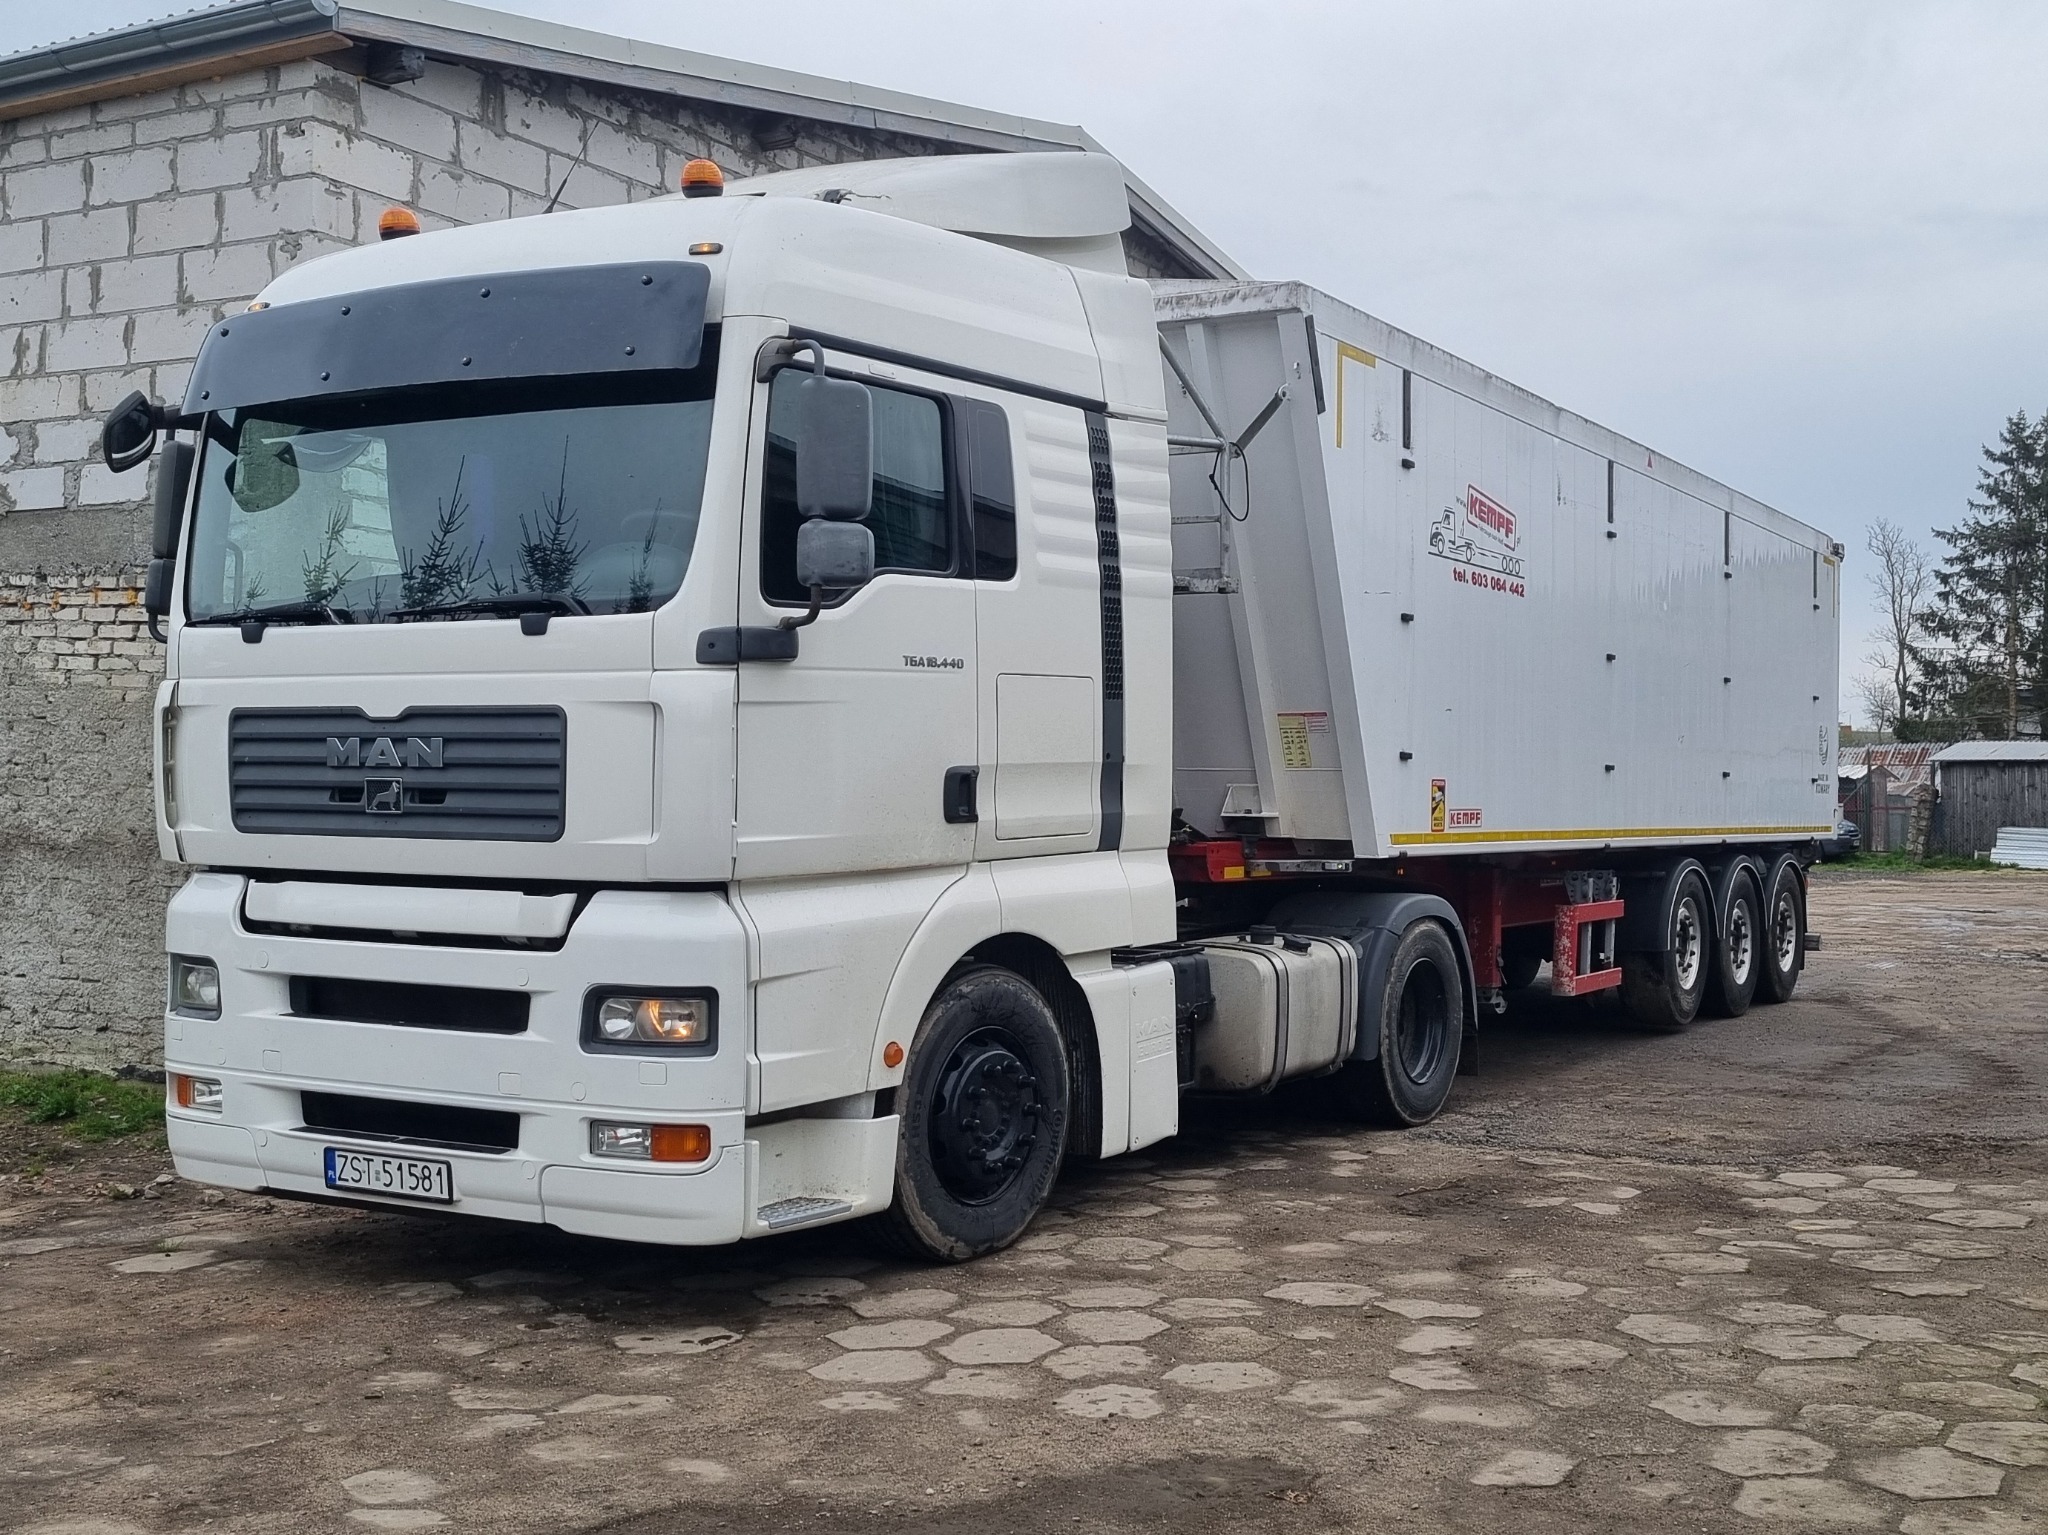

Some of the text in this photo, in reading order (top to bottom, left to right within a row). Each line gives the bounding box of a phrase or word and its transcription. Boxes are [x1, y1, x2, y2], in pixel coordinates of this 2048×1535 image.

[1470, 493, 1514, 538] KEMPF
[1453, 567, 1525, 598] tel. 603 064 442
[326, 737, 444, 767] MAN
[1450, 812, 1481, 825] KEMPF
[328, 1170, 336, 1179] PL
[337, 1154, 443, 1195] ZST 51581
